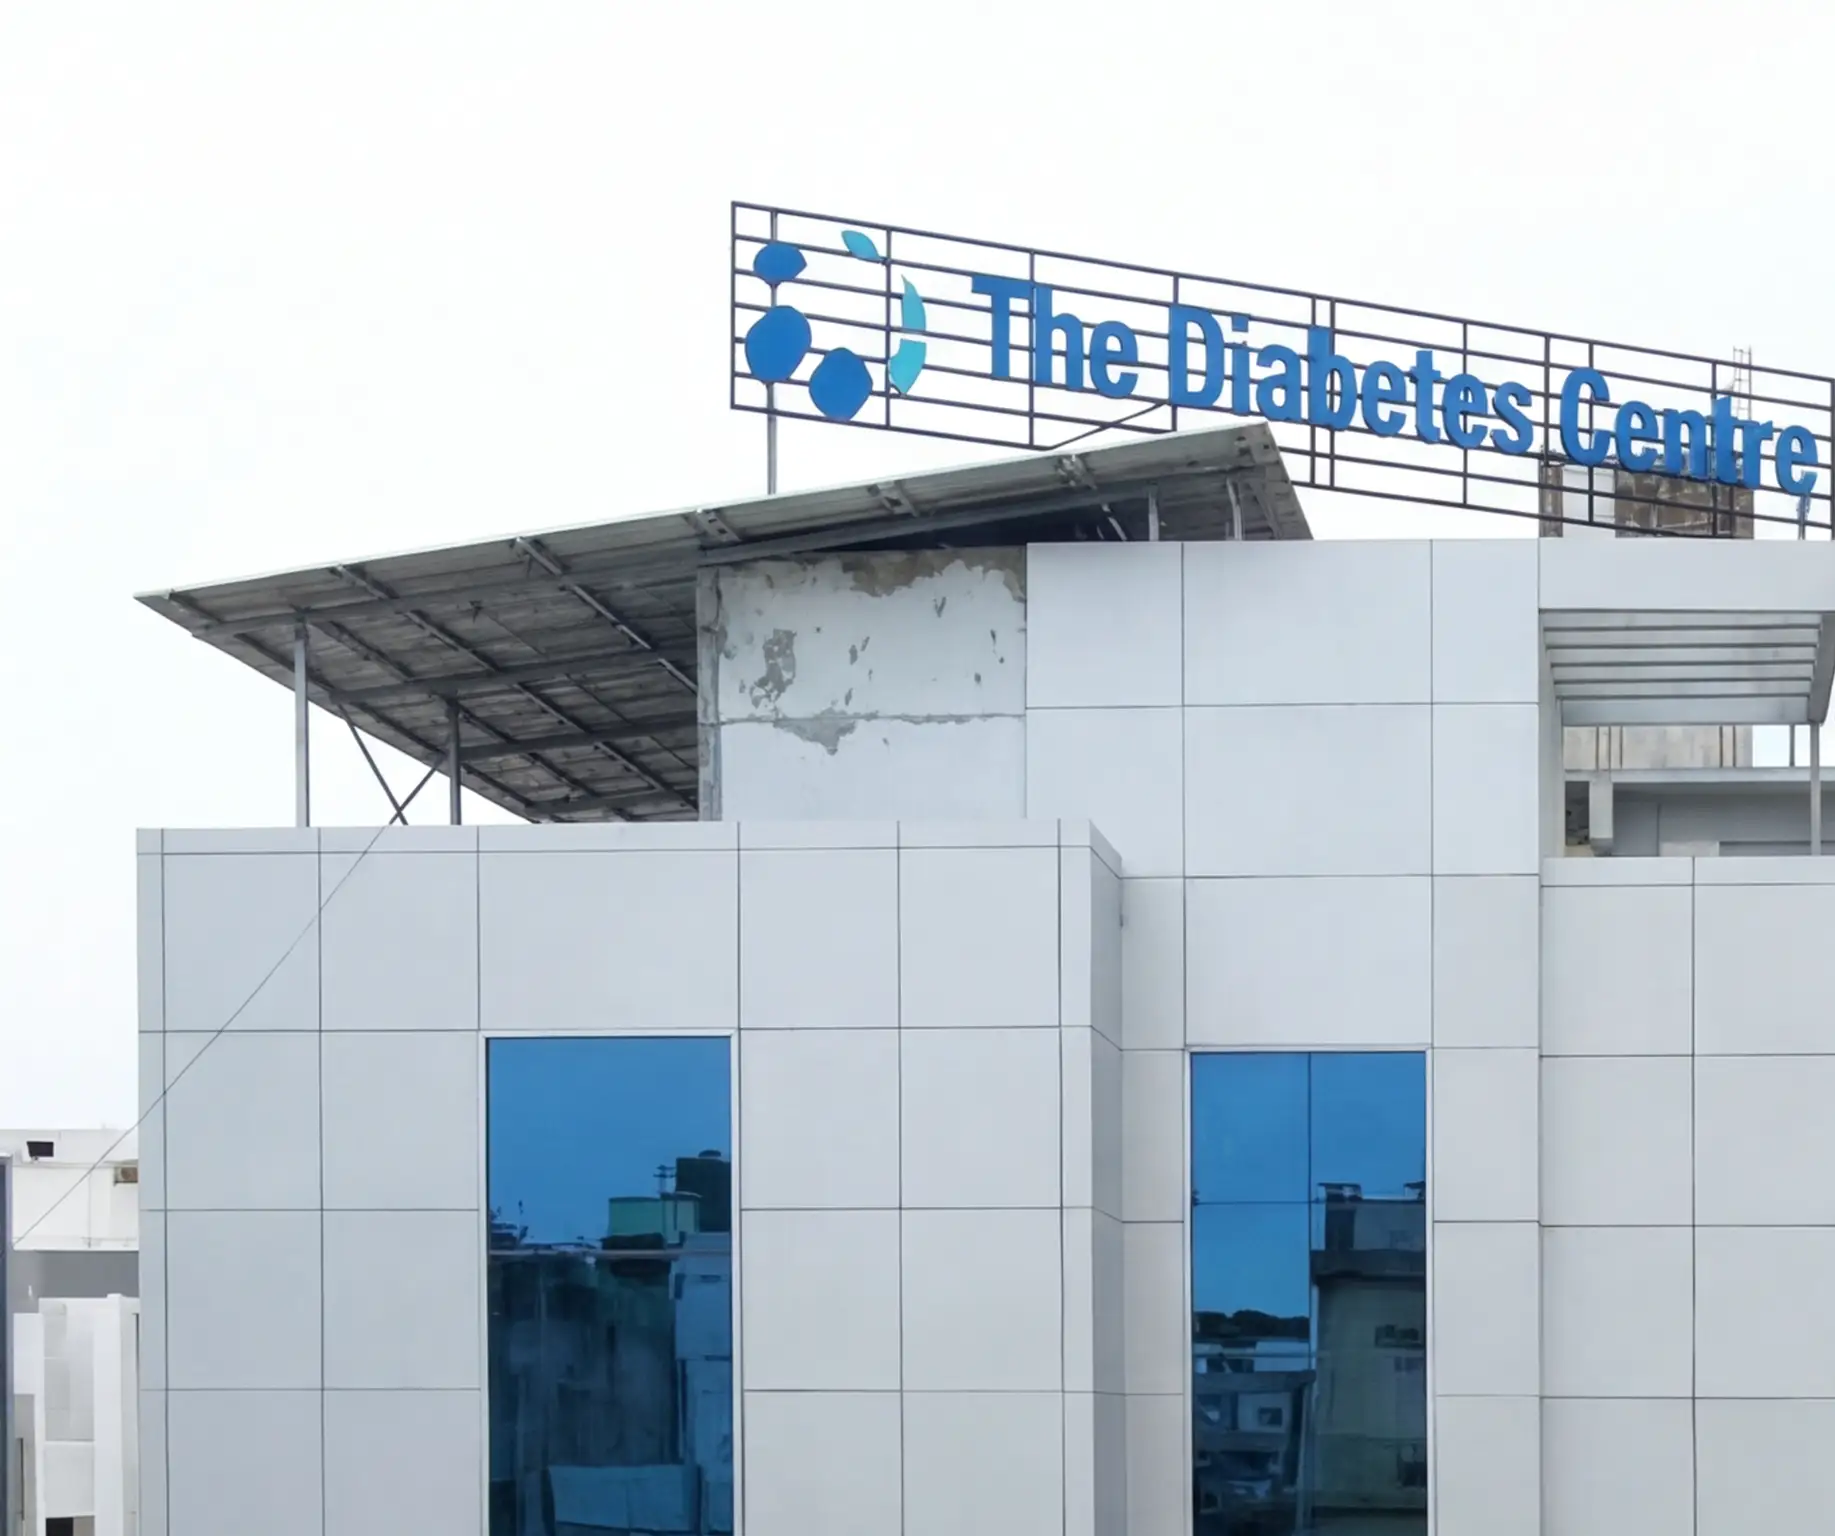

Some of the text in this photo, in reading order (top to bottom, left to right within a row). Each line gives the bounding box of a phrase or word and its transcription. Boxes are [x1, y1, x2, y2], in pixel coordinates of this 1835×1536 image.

[971, 274, 1818, 495] The Diabetes Centre
